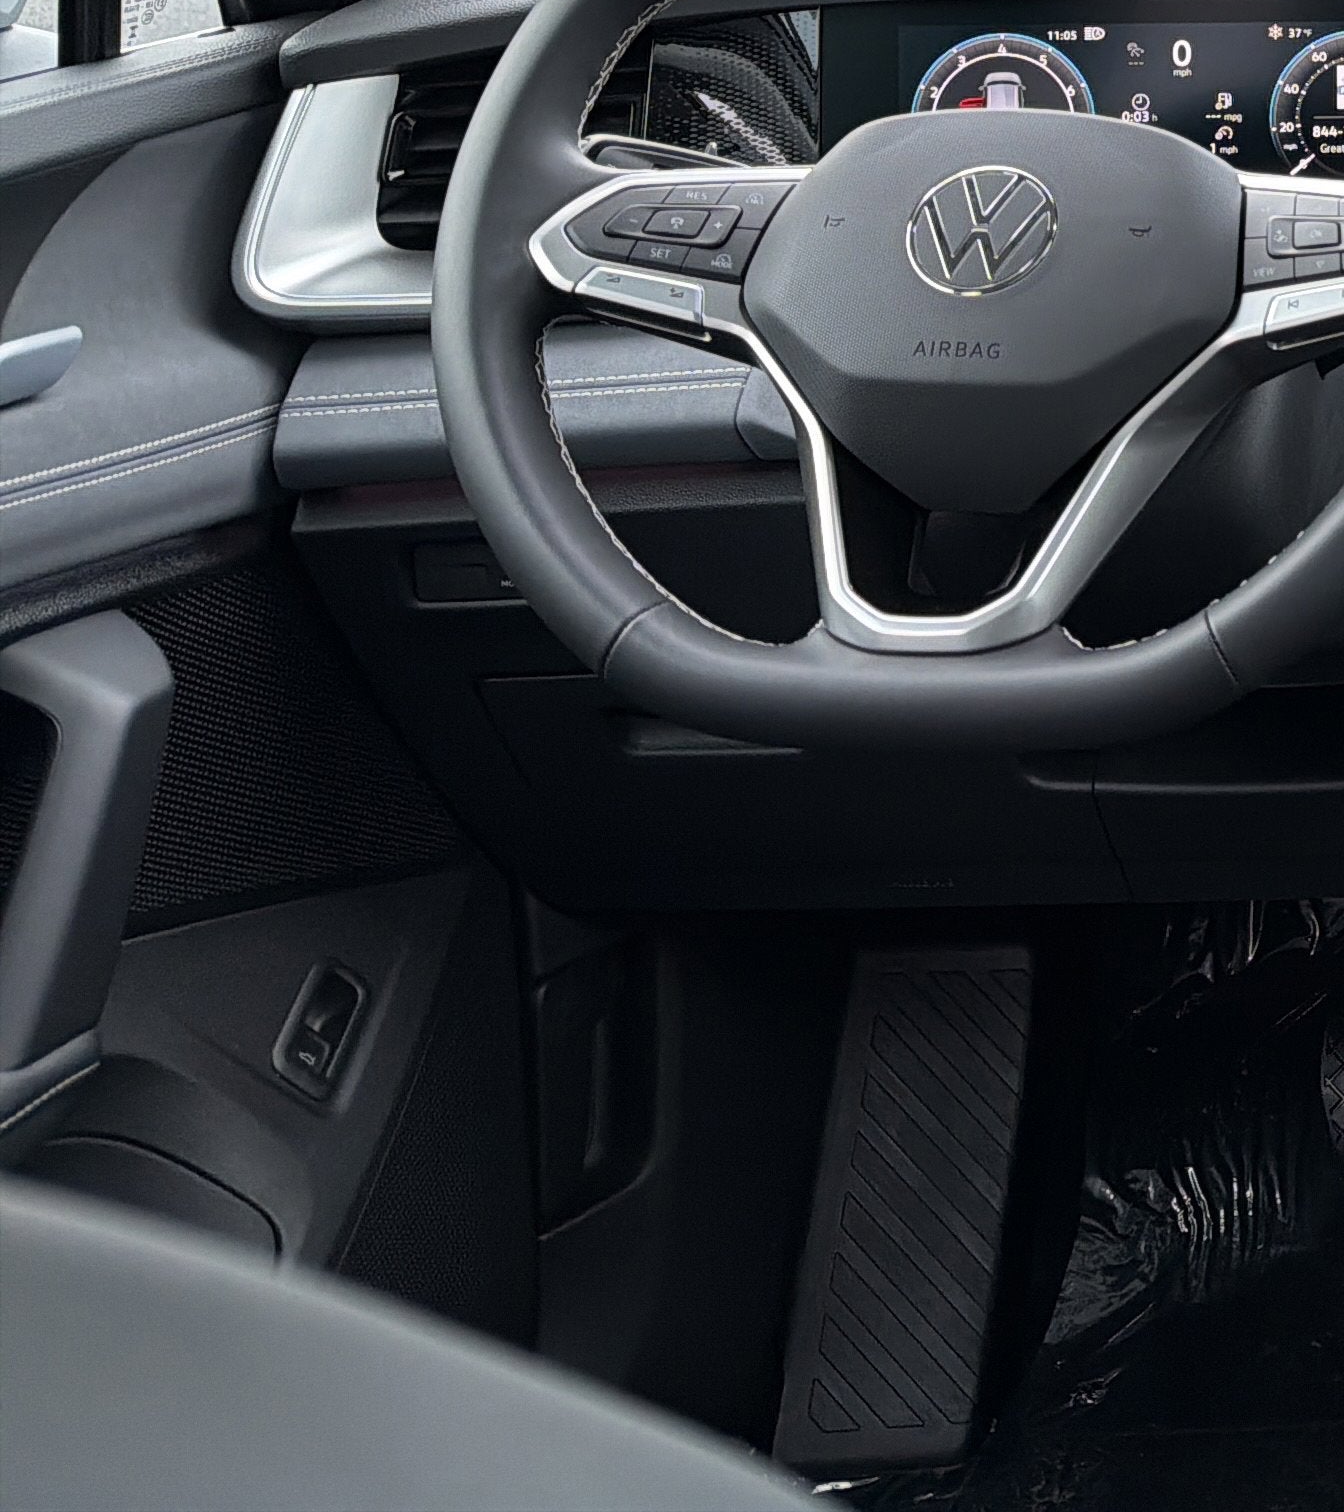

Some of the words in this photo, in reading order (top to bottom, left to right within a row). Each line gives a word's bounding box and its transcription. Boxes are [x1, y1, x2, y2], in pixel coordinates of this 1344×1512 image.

[1047, 30, 1077, 41] 11:05
[1288, 28, 1301, 37] 37
[997, 44, 1007, 53] 4
[1172, 40, 1192, 67] 0
[957, 56, 966, 66] 3
[1039, 56, 1048, 66] 5
[1312, 52, 1327, 62] 60
[1173, 68, 1192, 77] mph
[930, 87, 940, 98] 2
[1066, 87, 1075, 97] 6
[1284, 84, 1299, 94] 40
[1122, 111, 1150, 123] 0:03
[1224, 113, 1243, 123] mpg
[1280, 123, 1294, 133] 20
[1210, 143, 1216, 154] 1
[1220, 146, 1238, 154] mph
[1320, 143, 1344, 153] Great
[686, 192, 707, 201] RES
[650, 248, 670, 259] SET
[912, 340, 1002, 361] AIRBAG
